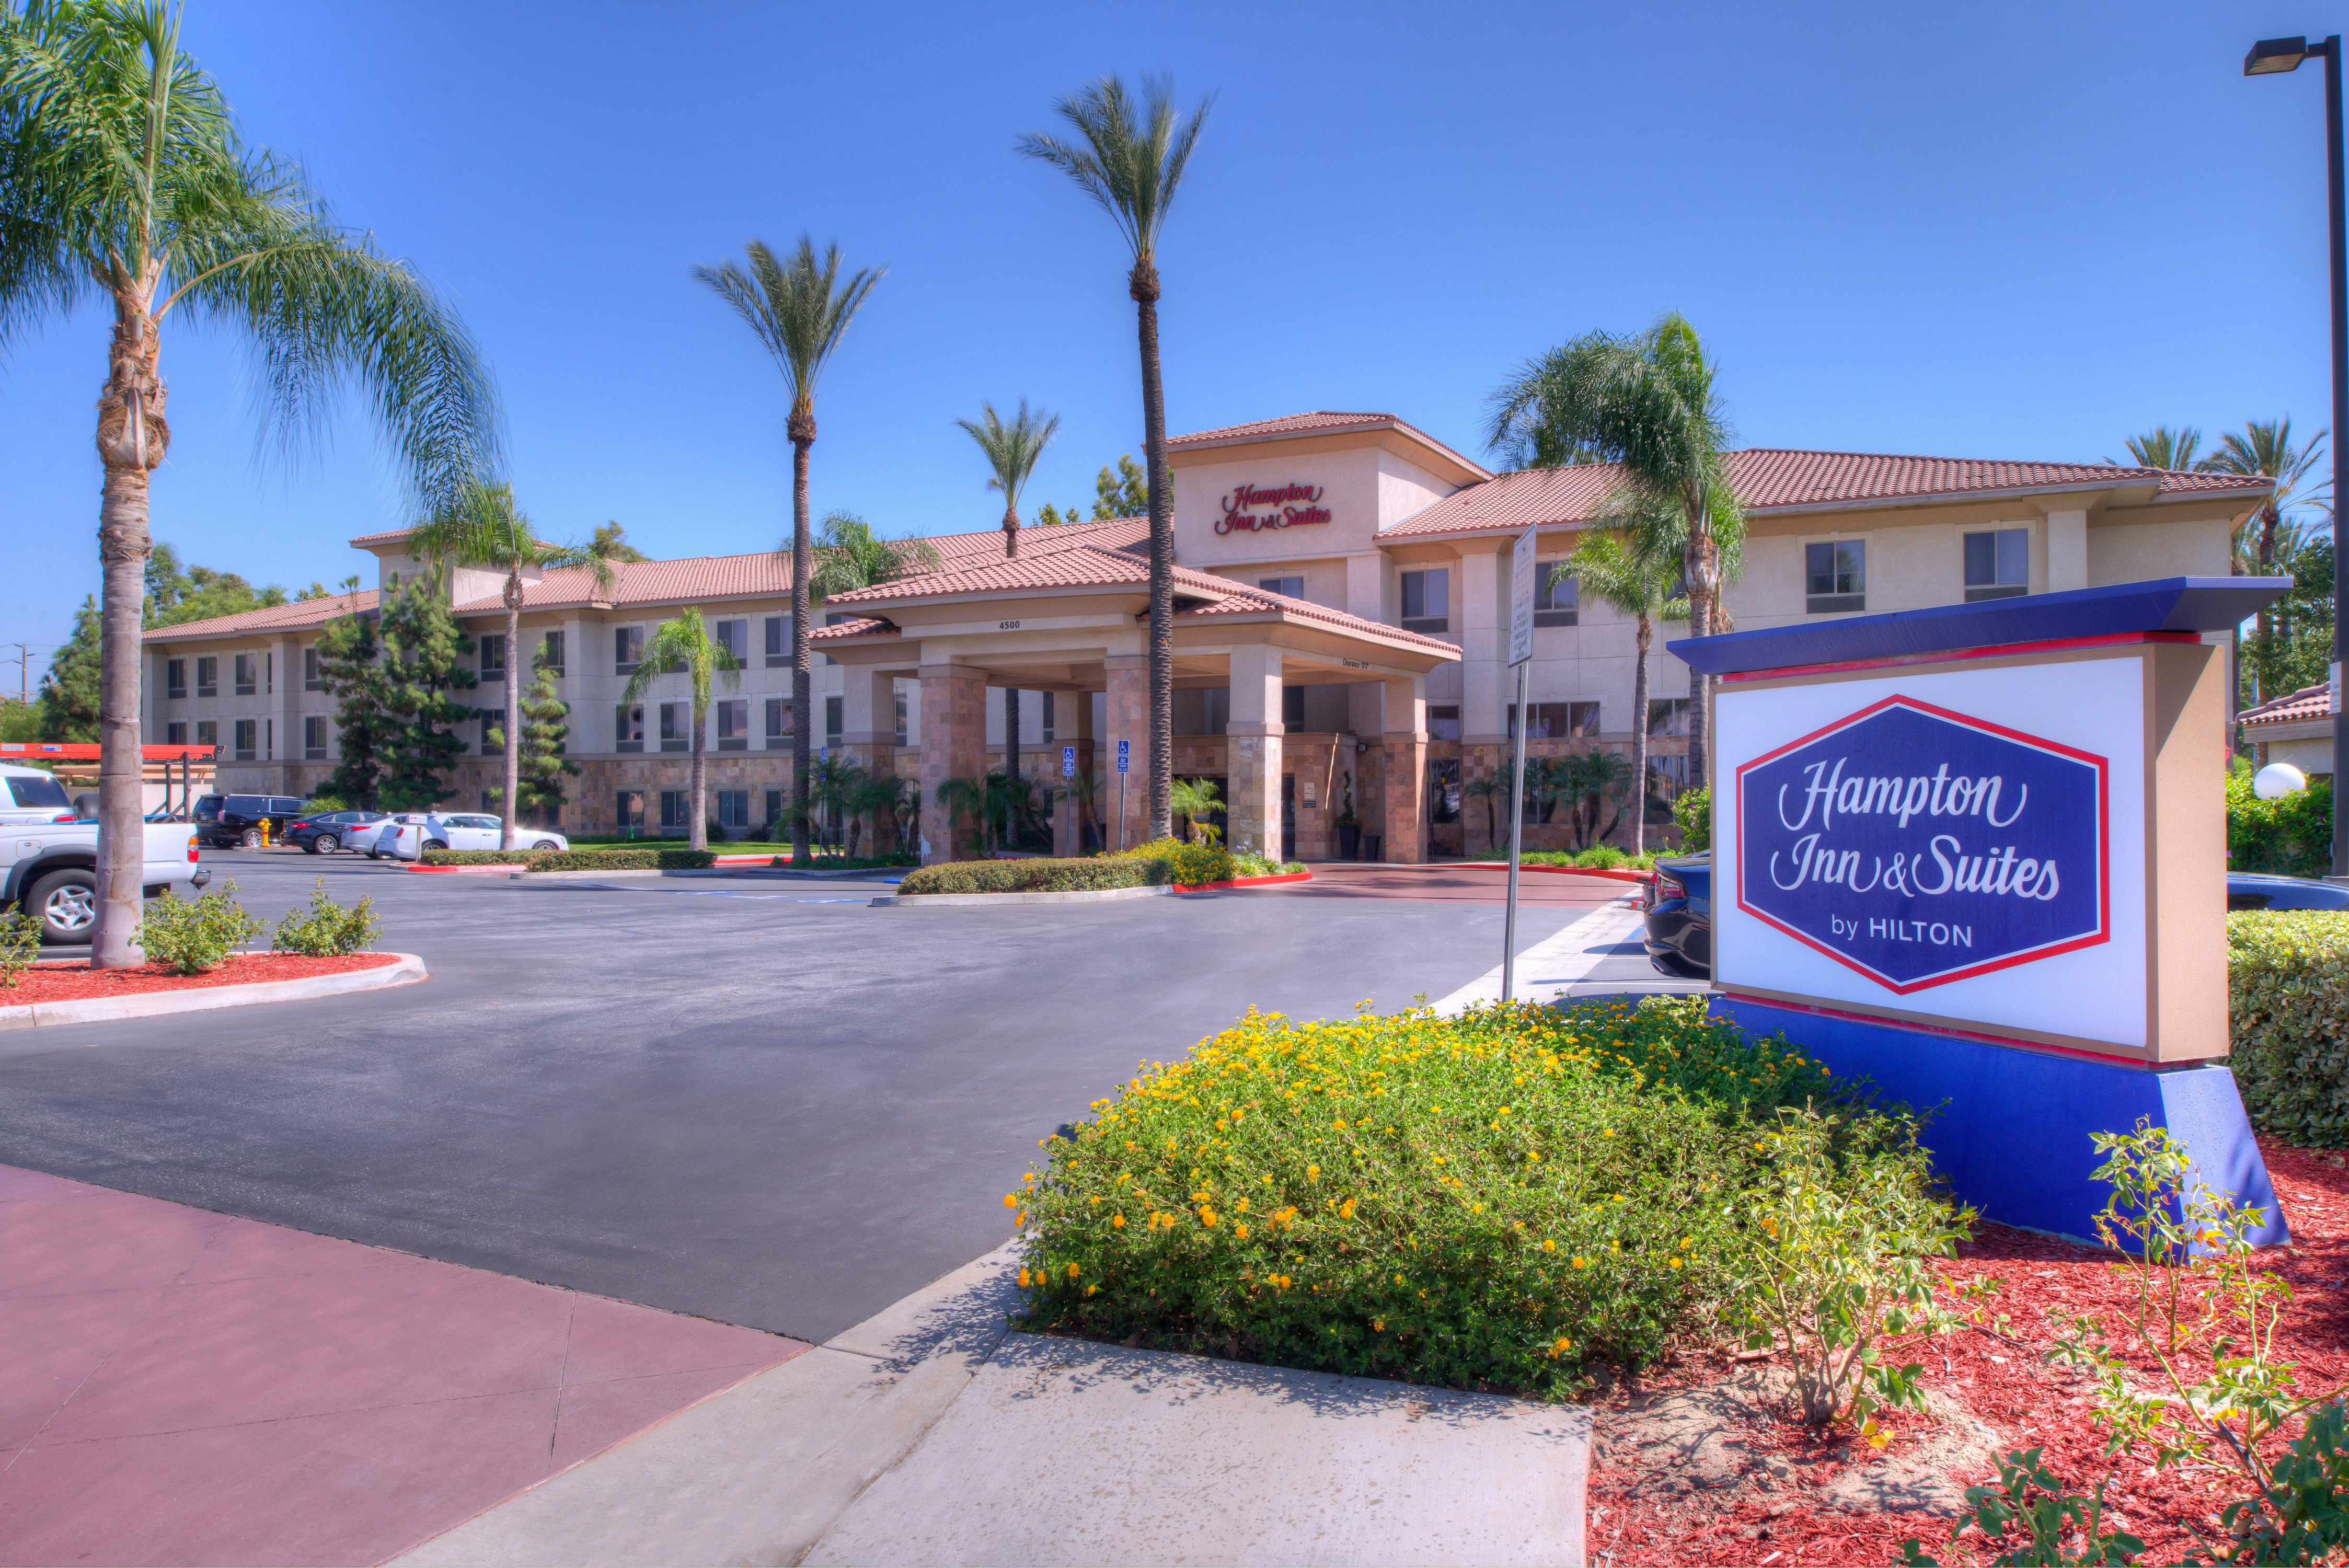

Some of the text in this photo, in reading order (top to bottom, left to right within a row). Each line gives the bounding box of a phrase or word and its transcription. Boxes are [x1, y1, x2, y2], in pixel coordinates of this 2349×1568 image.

[1222, 483, 1323, 513] Hampton
[1214, 505, 1331, 535] Inn & Suites
[999, 621, 1019, 629] 4500
[1343, 659, 1360, 668] Clearance
[1779, 757, 2028, 830] Hampton
[1770, 833, 2059, 901] Inn & Suites
[1832, 913, 1972, 948] by HILTON
